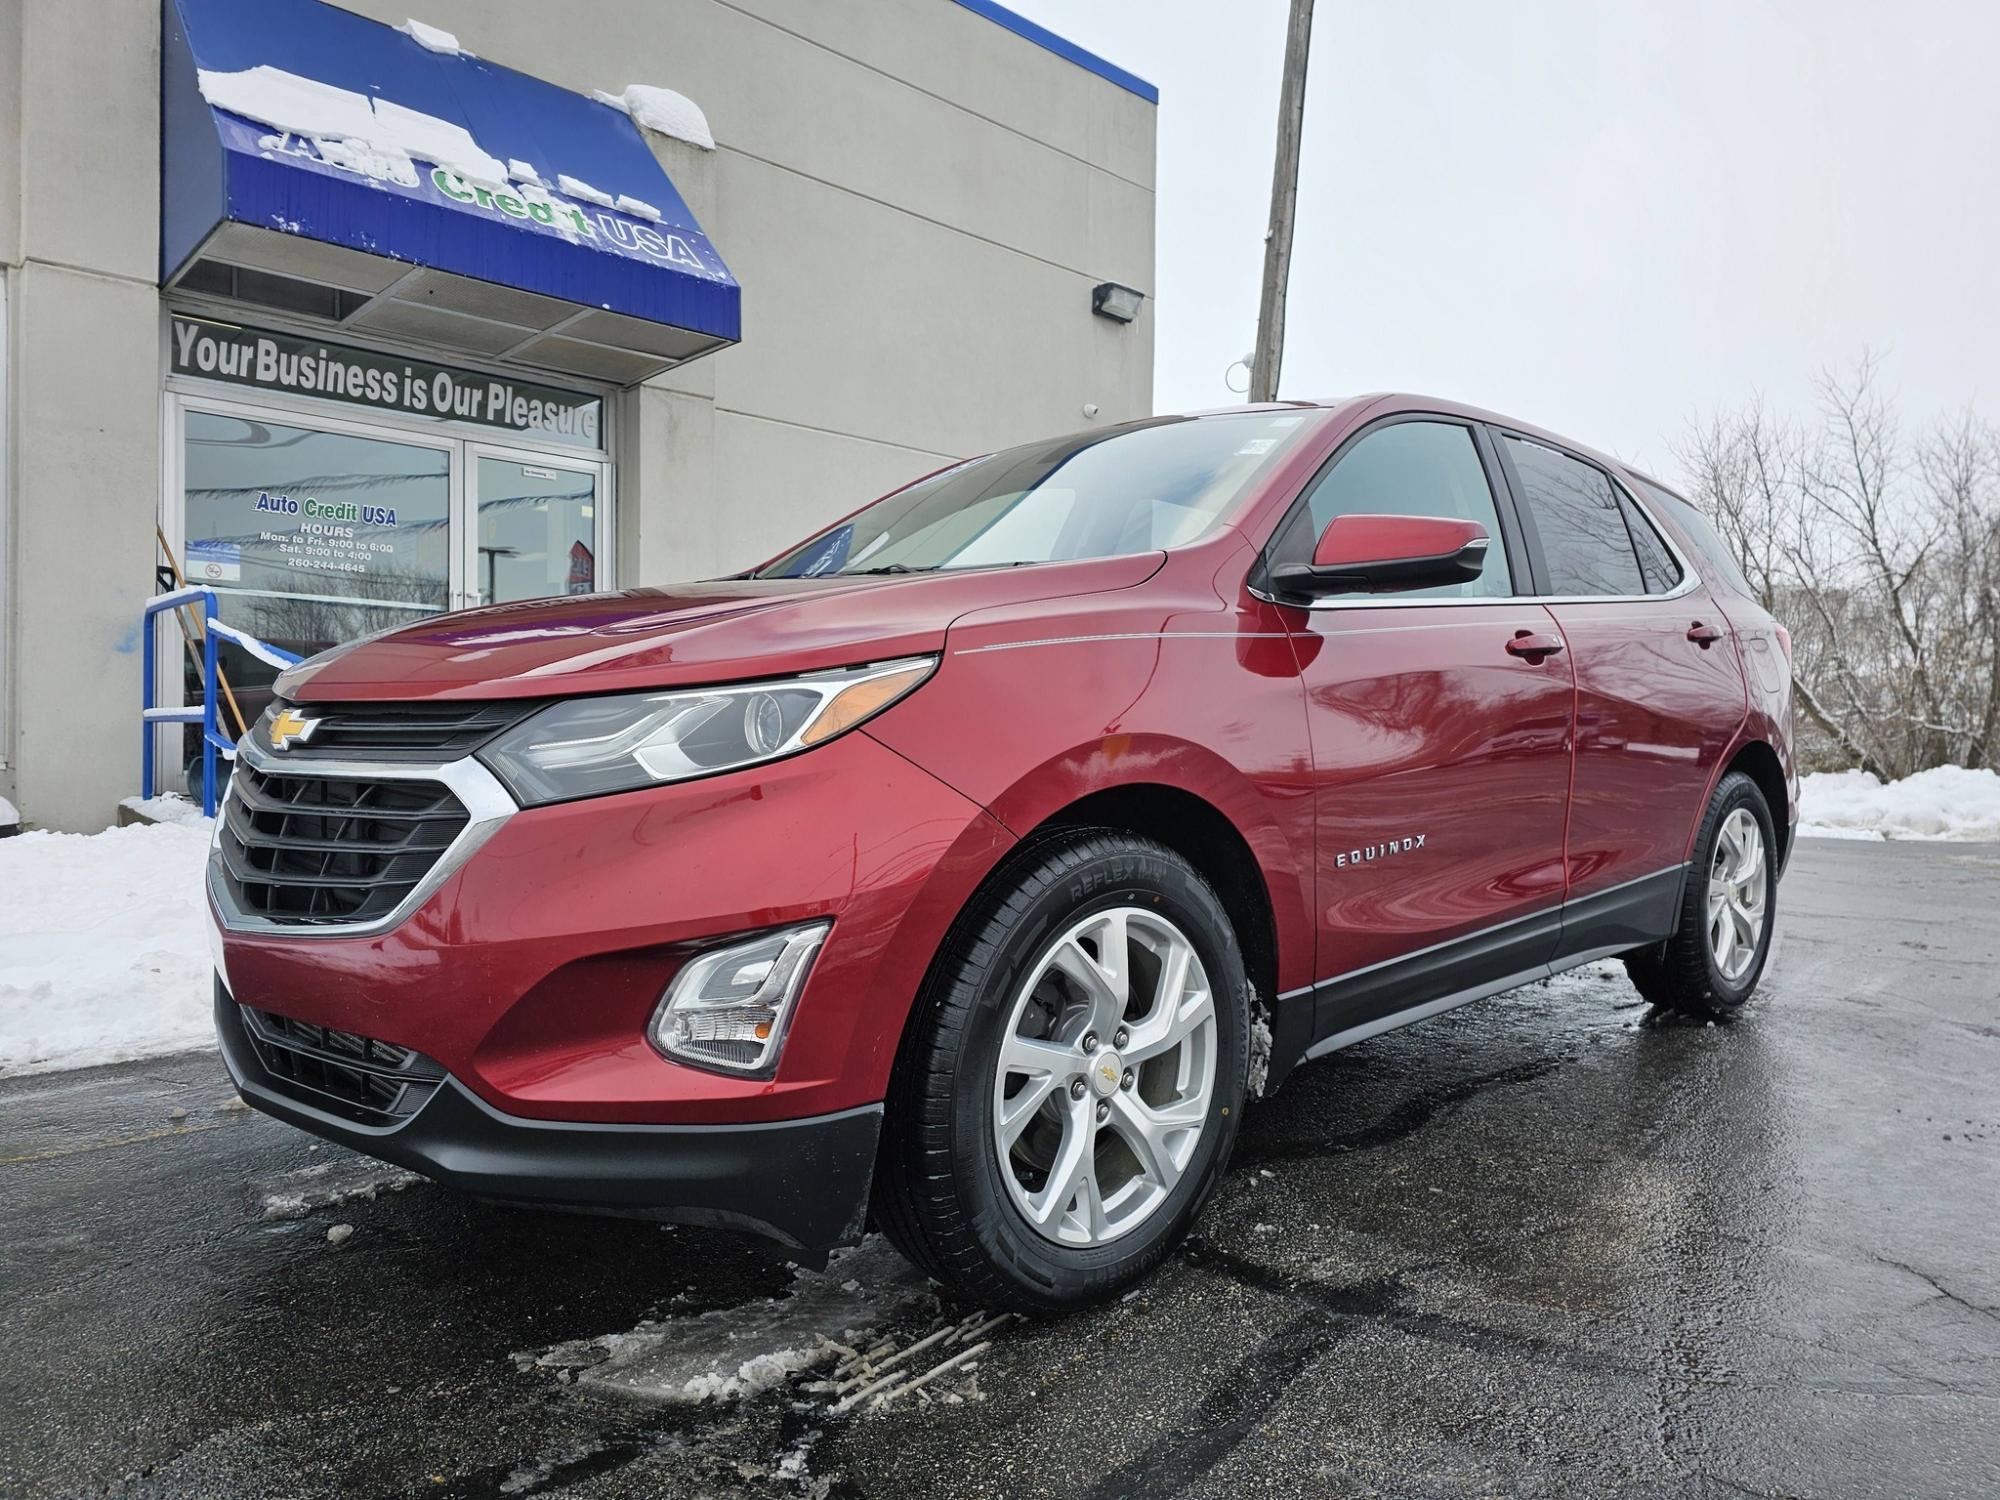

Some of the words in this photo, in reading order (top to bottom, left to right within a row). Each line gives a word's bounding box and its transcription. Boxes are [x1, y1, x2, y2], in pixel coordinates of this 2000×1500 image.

[598, 213, 705, 270] USA
[174, 321, 254, 378] Your
[255, 338, 398, 404] Business
[403, 367, 428, 410] is
[432, 371, 483, 418] Our
[486, 382, 600, 439] Pleasure
[252, 491, 299, 515] Auto
[303, 497, 359, 522] Credit
[361, 505, 398, 528] USA
[260, 531, 289, 543] Mon.
[292, 534, 304, 544] to
[307, 535, 325, 547] Fri.
[328, 538, 353, 550] 9:00
[356, 540, 367, 551] to
[299, 522, 354, 538] HOURS
[279, 544, 302, 555] Sat.
[305, 546, 331, 558] 9:00
[333, 548, 345, 559] to
[347, 550, 372, 562] 4:00
[1334, 833, 1426, 869] EQUINOX
